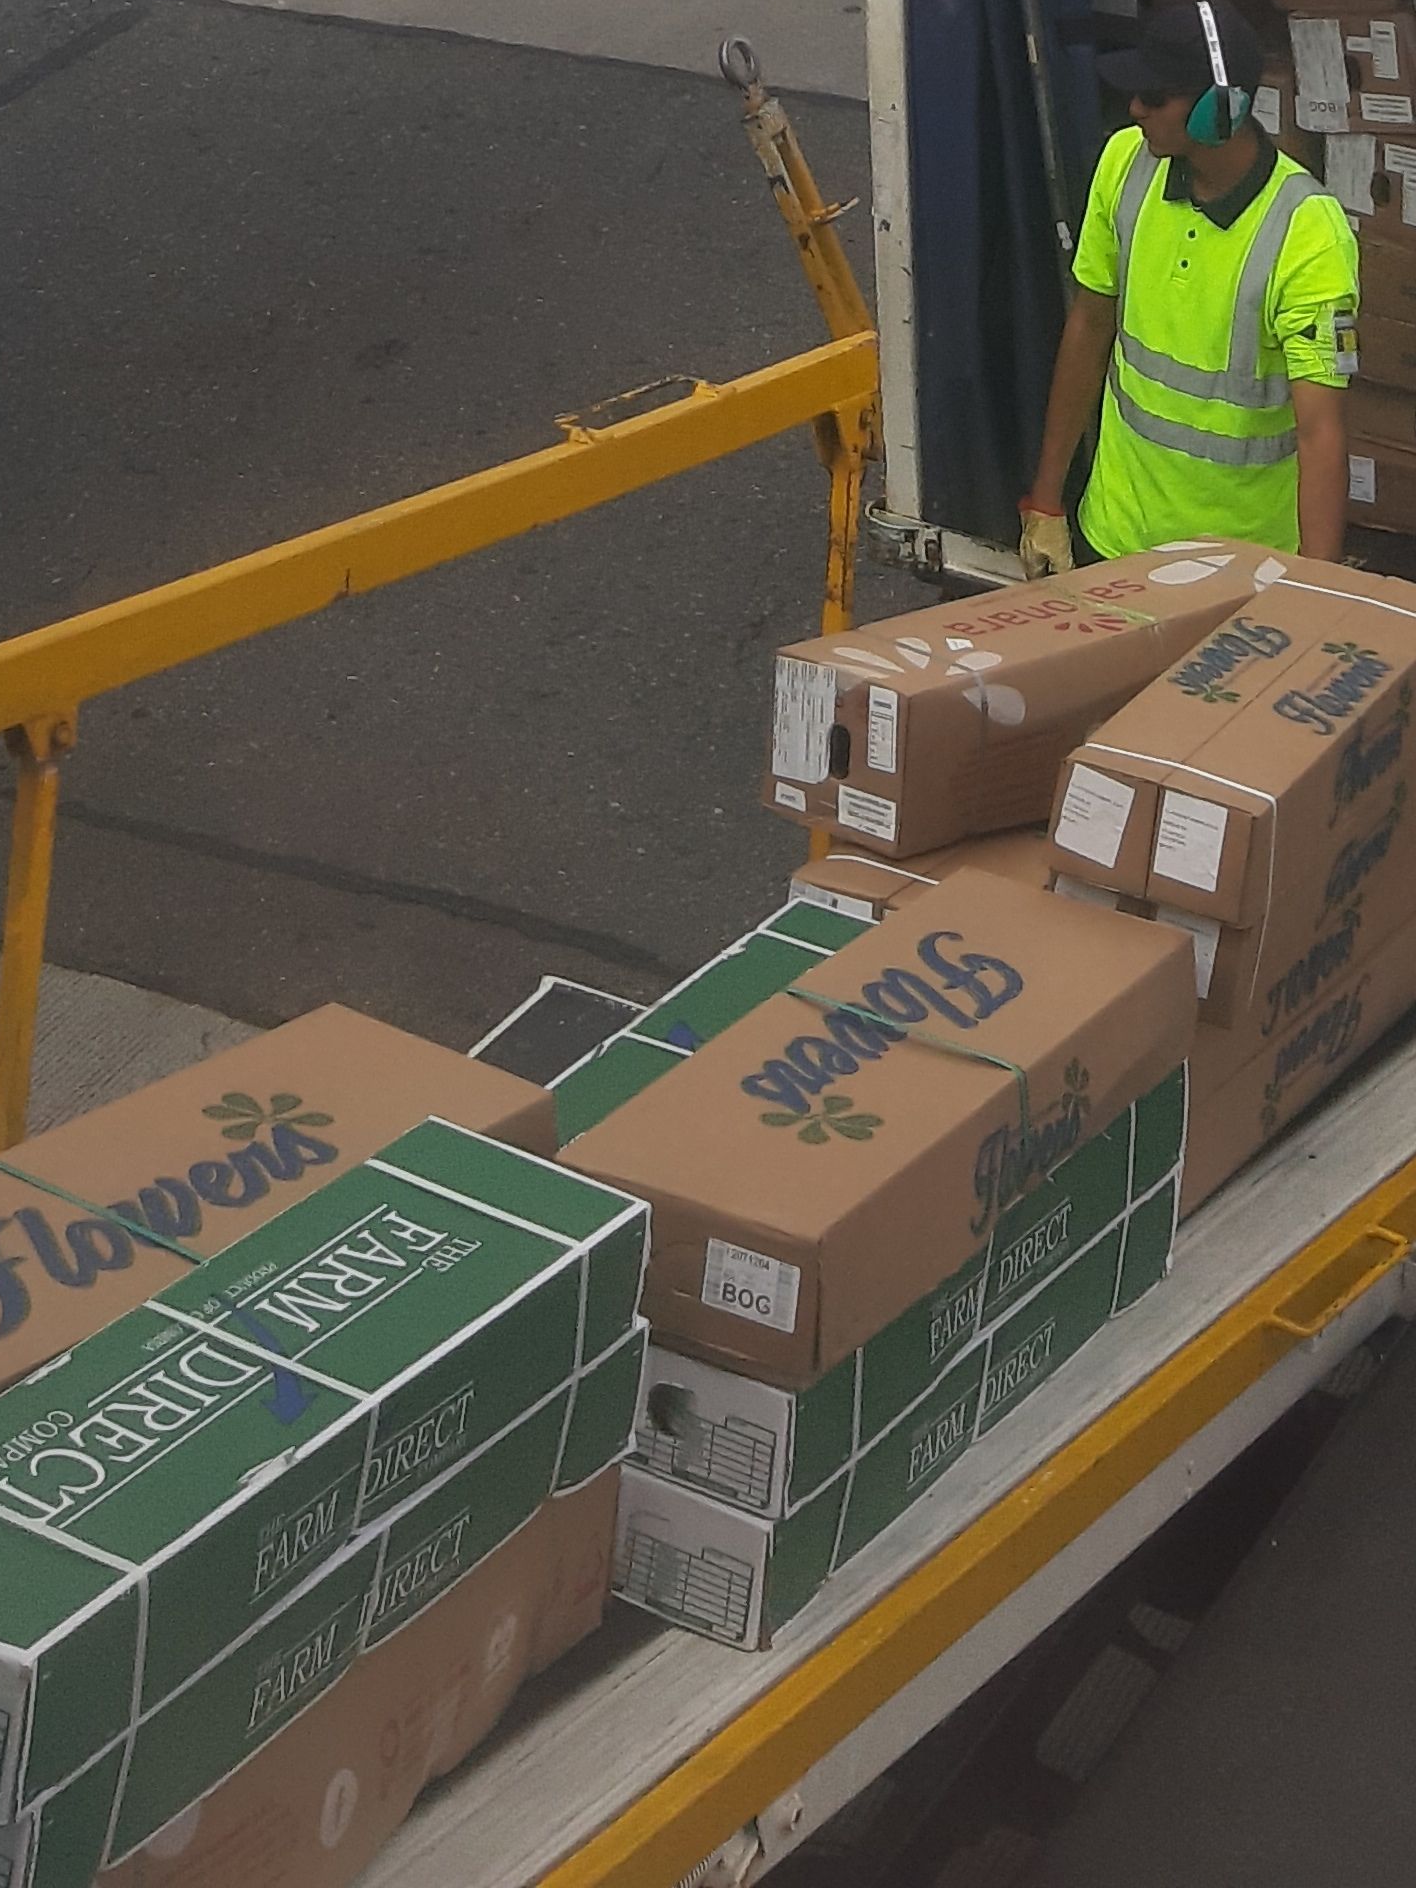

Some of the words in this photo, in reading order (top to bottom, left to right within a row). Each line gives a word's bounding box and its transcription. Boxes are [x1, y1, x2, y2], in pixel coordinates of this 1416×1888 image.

[942, 578, 1147, 636] saonara
[739, 930, 1024, 1115] Flowers
[253, 1210, 449, 1335] FARM
[421, 1235, 483, 1274] THE
[721, 1282, 772, 1315] BOG
[929, 1273, 985, 1359] FARM
[997, 1201, 1074, 1295] DIRECT
[906, 1402, 968, 1485] FARM
[983, 1321, 1057, 1411] DIRECT
[253, 1488, 340, 1595] FARM
[364, 1389, 476, 1501] DIRECT
[248, 1622, 340, 1729] FARM
